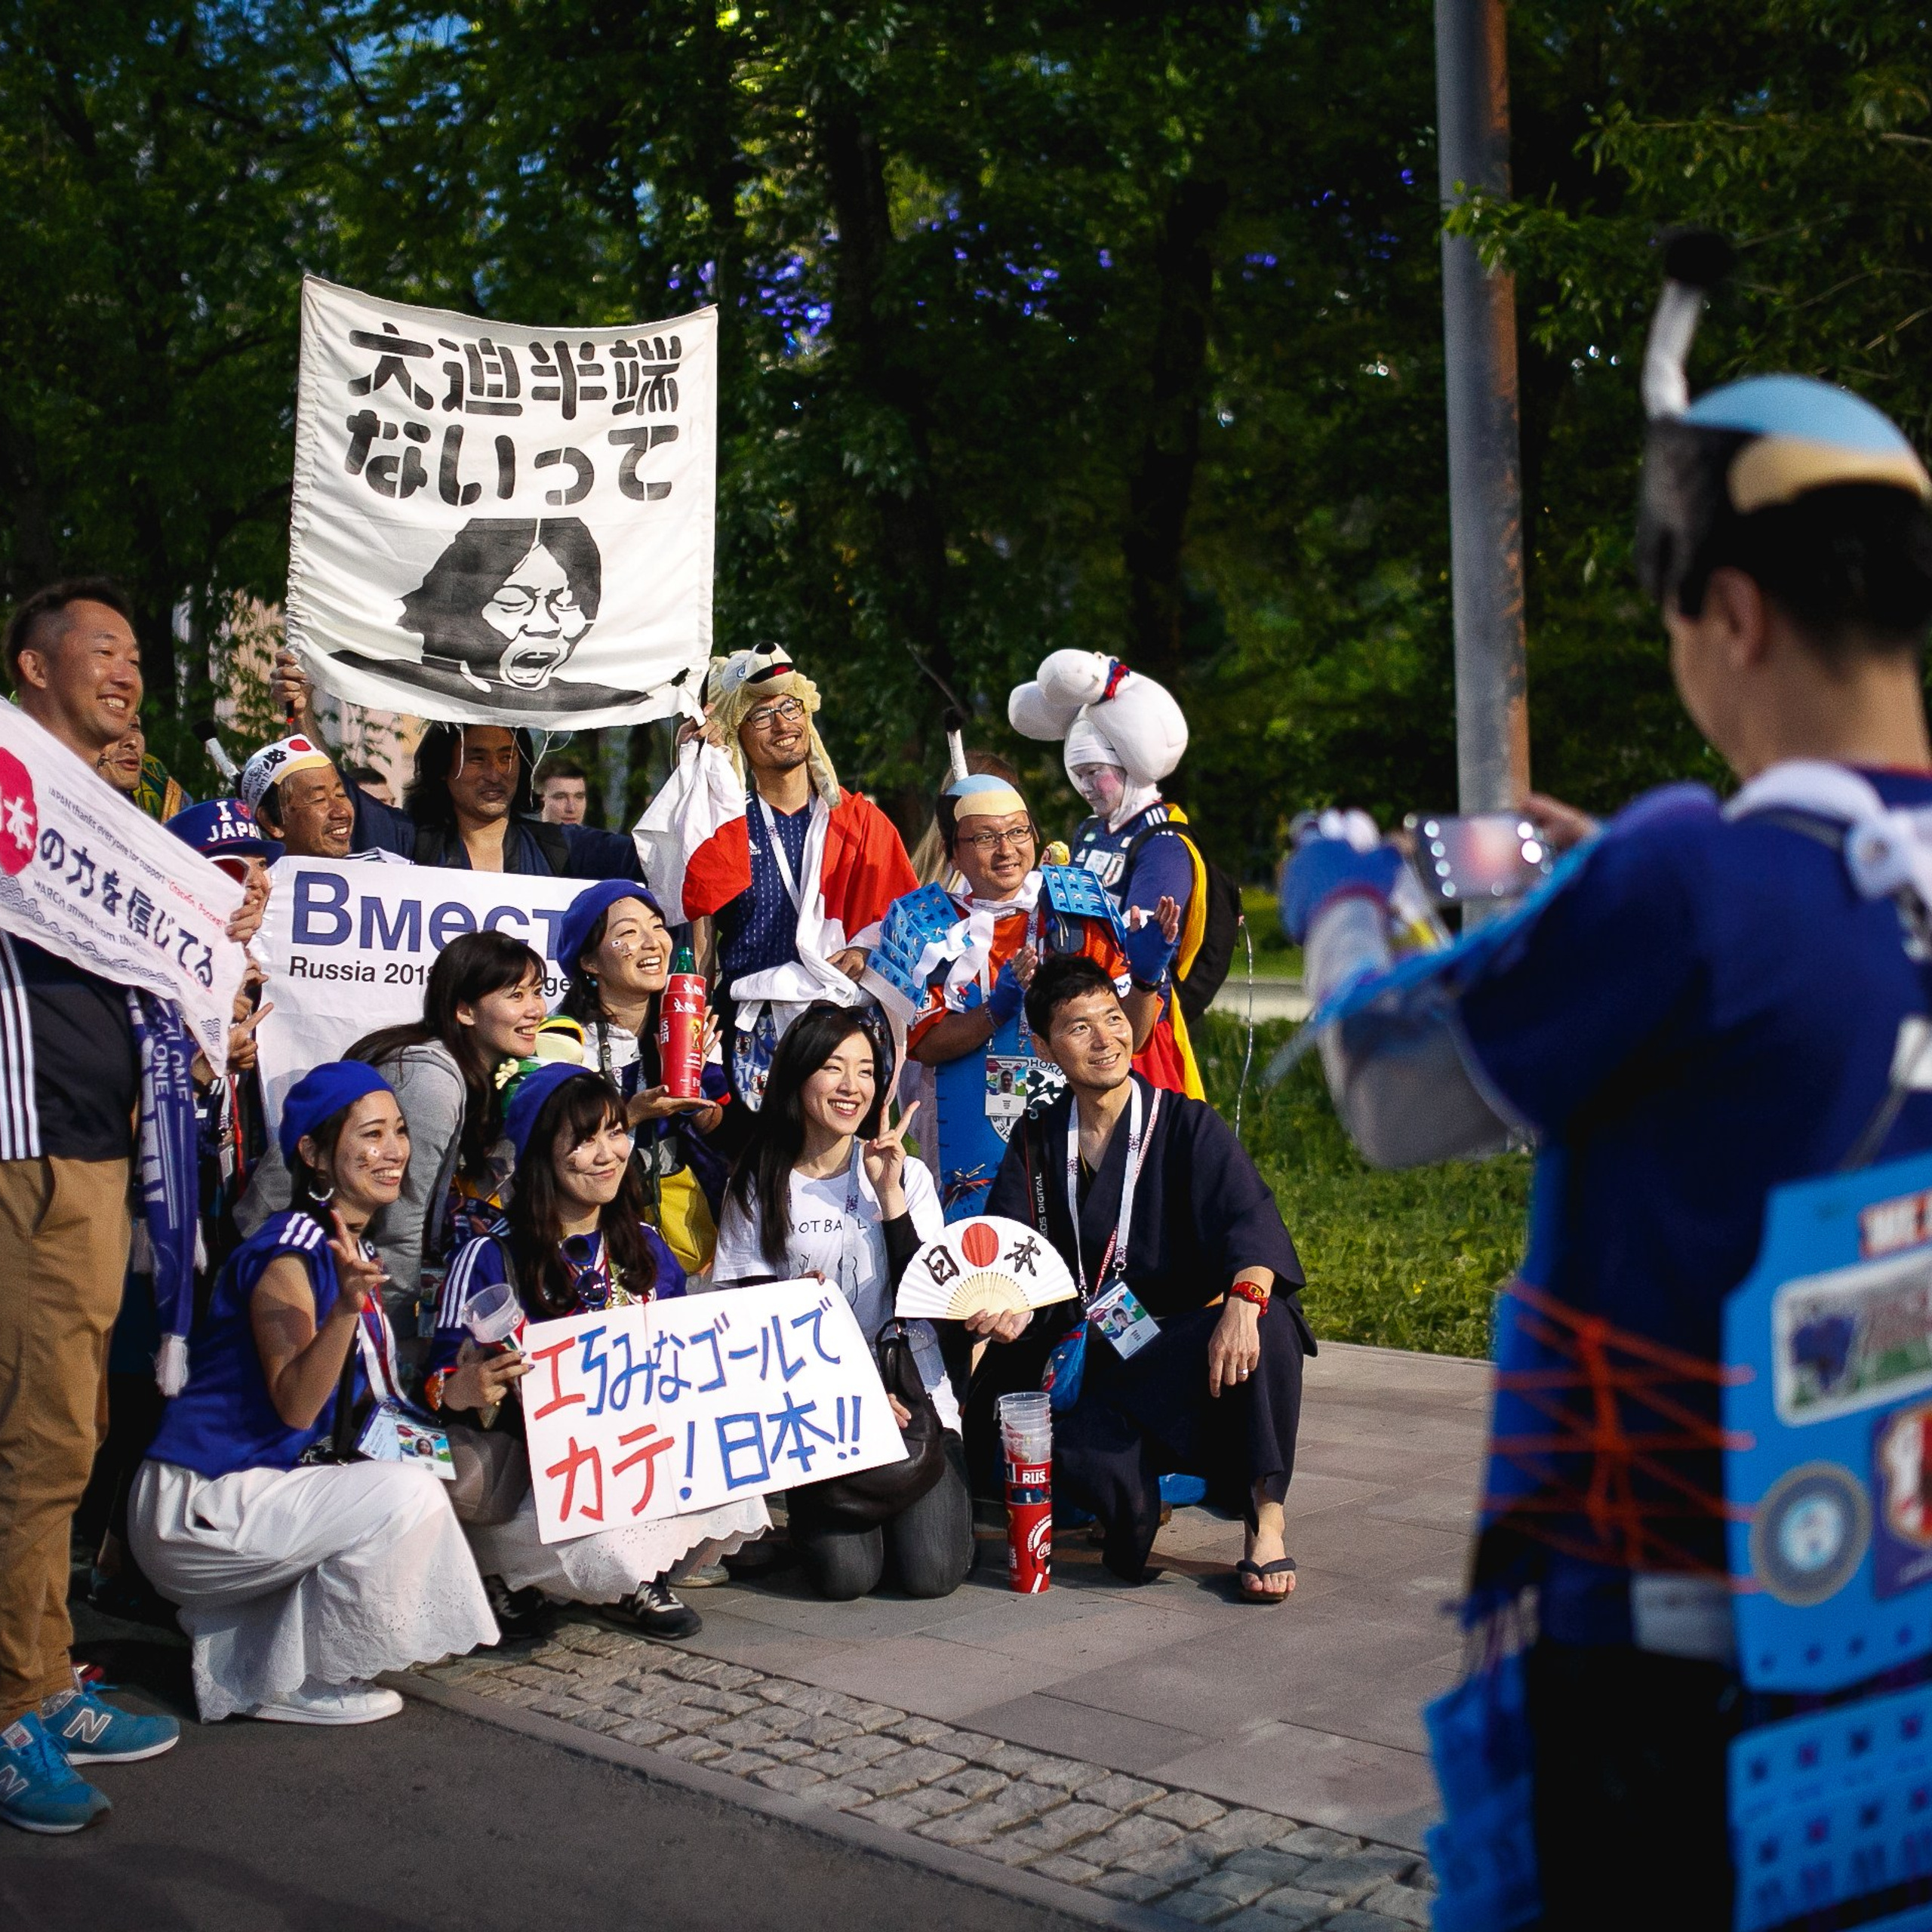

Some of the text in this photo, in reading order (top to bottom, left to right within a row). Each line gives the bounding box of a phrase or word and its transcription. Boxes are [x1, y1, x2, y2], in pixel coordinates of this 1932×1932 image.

[348, 321, 681, 420] 大迫半端
[344, 409, 679, 506] ないって
[289, 956, 376, 983] Russia
[1035, 1172, 1046, 1214] DIGITAL
[1023, 1472, 1046, 1484] RUS
[62, 1708, 112, 1743] N
[0, 1764, 29, 1803] N
